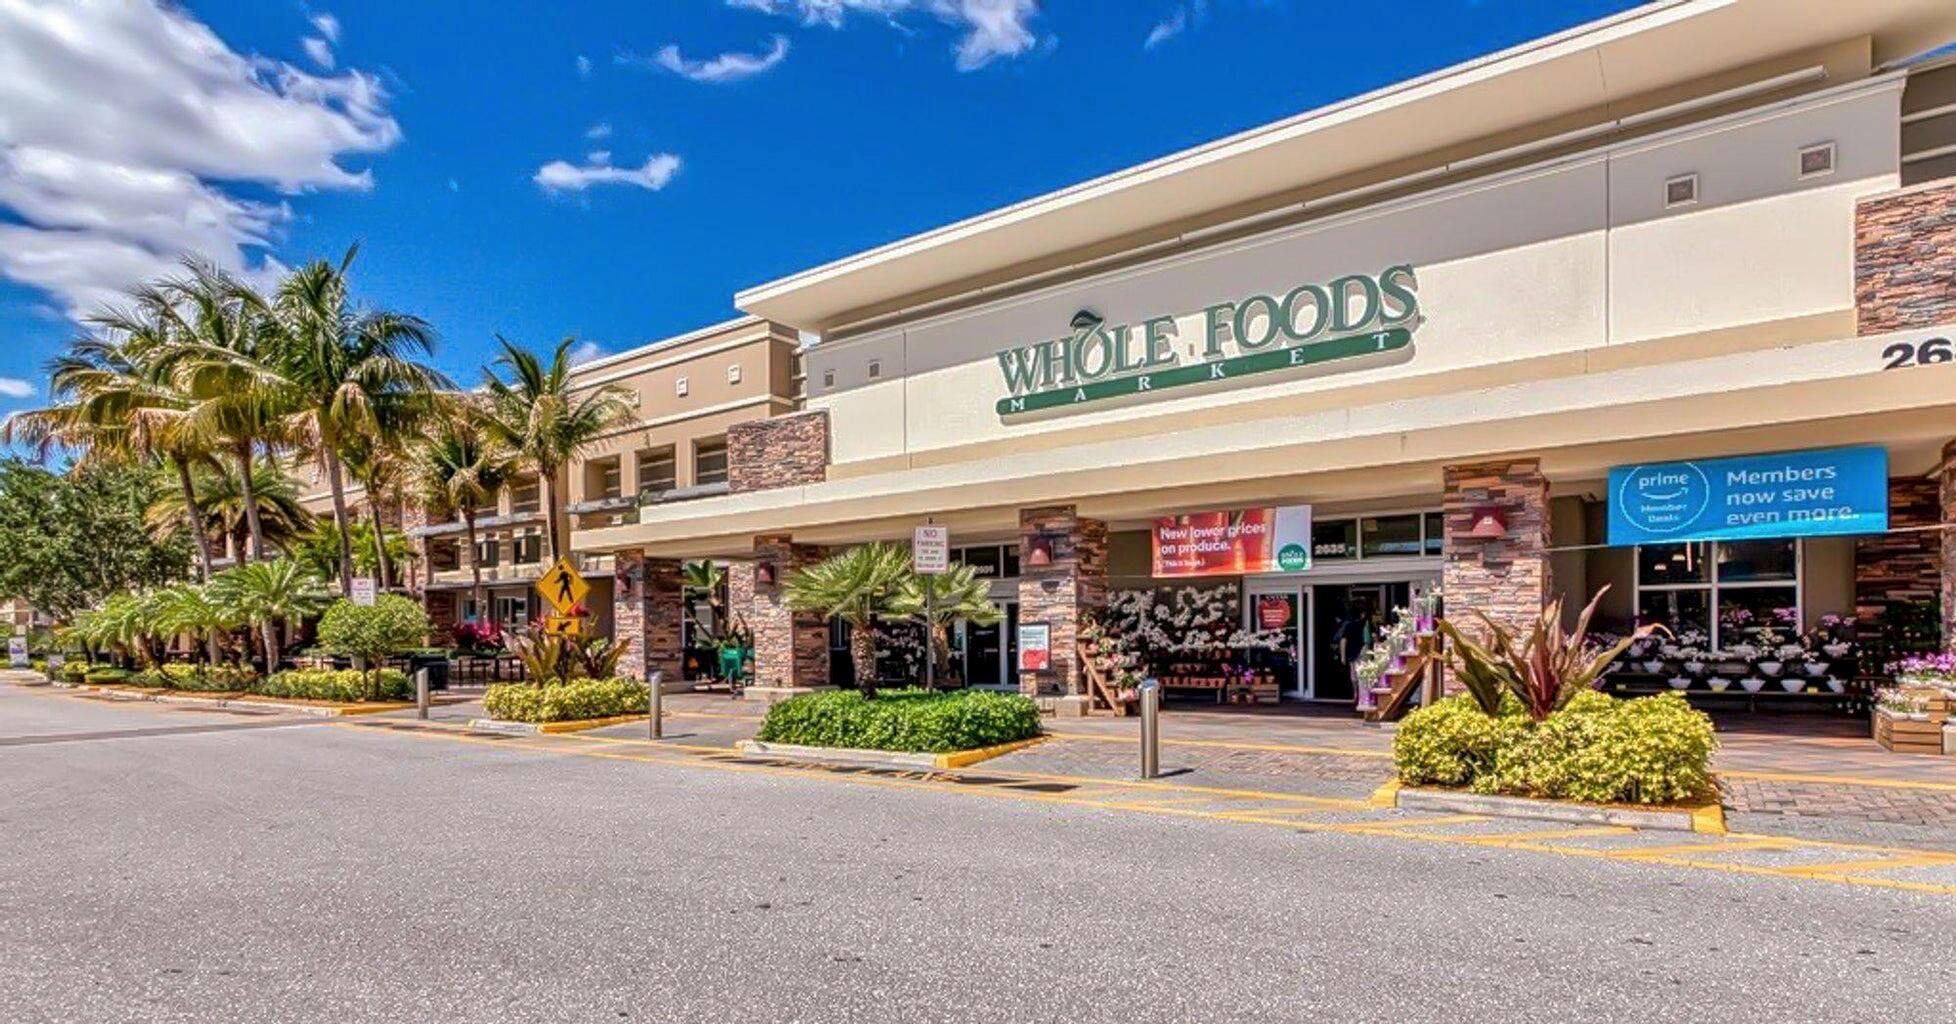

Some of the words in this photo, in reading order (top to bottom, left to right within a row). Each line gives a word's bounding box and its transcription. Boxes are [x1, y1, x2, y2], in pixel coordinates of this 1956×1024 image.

[998, 310, 1179, 394] WHOLE
[1202, 264, 1418, 357] FOODS
[1882, 338, 1956, 370] 26
[1009, 332, 1391, 413] MARKET
[1638, 472, 1689, 490] prime
[1726, 464, 1837, 486] Members
[1726, 492, 1775, 506] now
[1783, 485, 1835, 502] save
[1726, 511, 1780, 526] even
[1787, 505, 1860, 523] more.
[923, 529, 937, 537] NO
[1160, 527, 1187, 540] New
[1190, 525, 1225, 539] lower
[1228, 522, 1267, 538] prices
[1161, 543, 1176, 555] on
[1178, 540, 1232, 557] produce.
